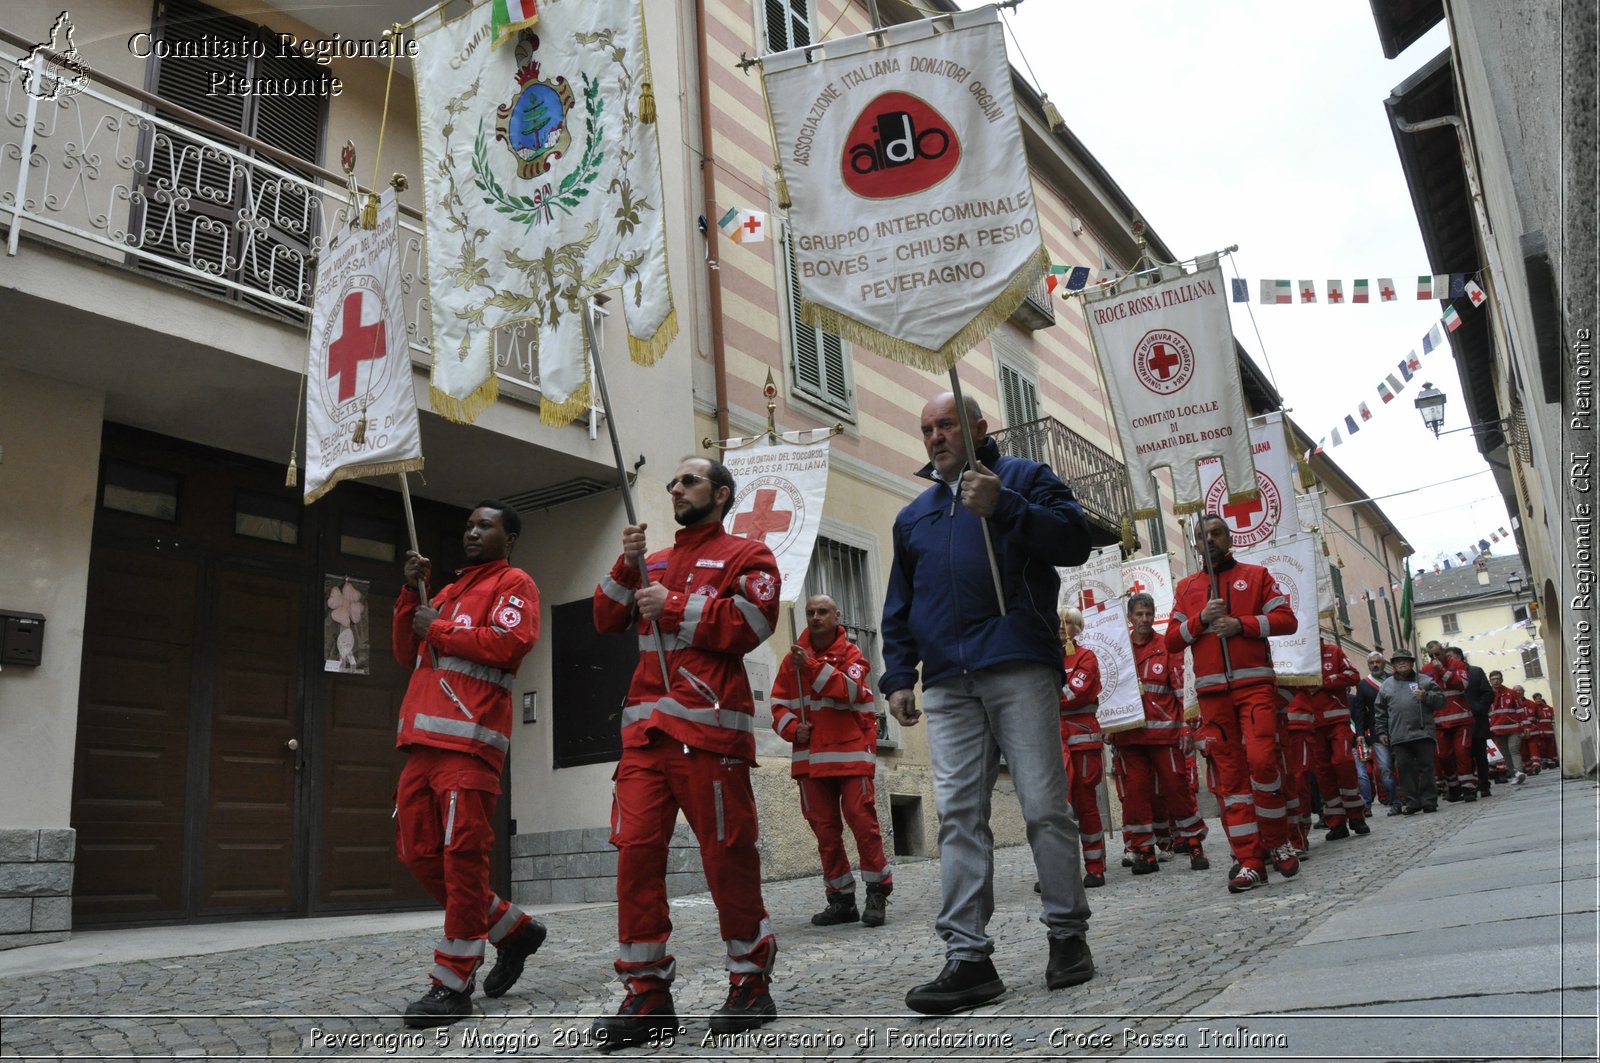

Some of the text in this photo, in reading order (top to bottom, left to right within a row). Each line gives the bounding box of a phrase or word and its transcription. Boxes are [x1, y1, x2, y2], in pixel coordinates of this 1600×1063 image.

[793, 56, 1005, 166] ASSOCIAZIONE ITALIANA DONATORI ORGANI
[849, 112, 949, 174] aido
[800, 191, 1029, 251] GRUPPO INTERCOMUNALE
[802, 255, 869, 278] BOVES
[896, 233, 970, 261] CHIUSA
[977, 218, 1034, 246] PESIO
[860, 261, 986, 301] PEVERAGNO
[1094, 279, 1216, 325] CROCE ROSSA ITALIANA
[384, 413, 395, 430] DI
[1132, 400, 1220, 429] COMITATO LOCALE
[1170, 423, 1179, 433] DI
[1179, 431, 1199, 445] DEL
[1201, 426, 1233, 441] BOSCO
[752, 464, 783, 475] ROSSA
[785, 459, 827, 472] ITALIANA
[778, 452, 790, 462] DEL
[792, 448, 824, 459] SOCCORSO
[782, 480, 804, 511] GINEVRA
[1256, 521, 1273, 539] 1864
[1093, 633, 1128, 661] ITALIANA
[1278, 637, 1307, 648] LOCALE
